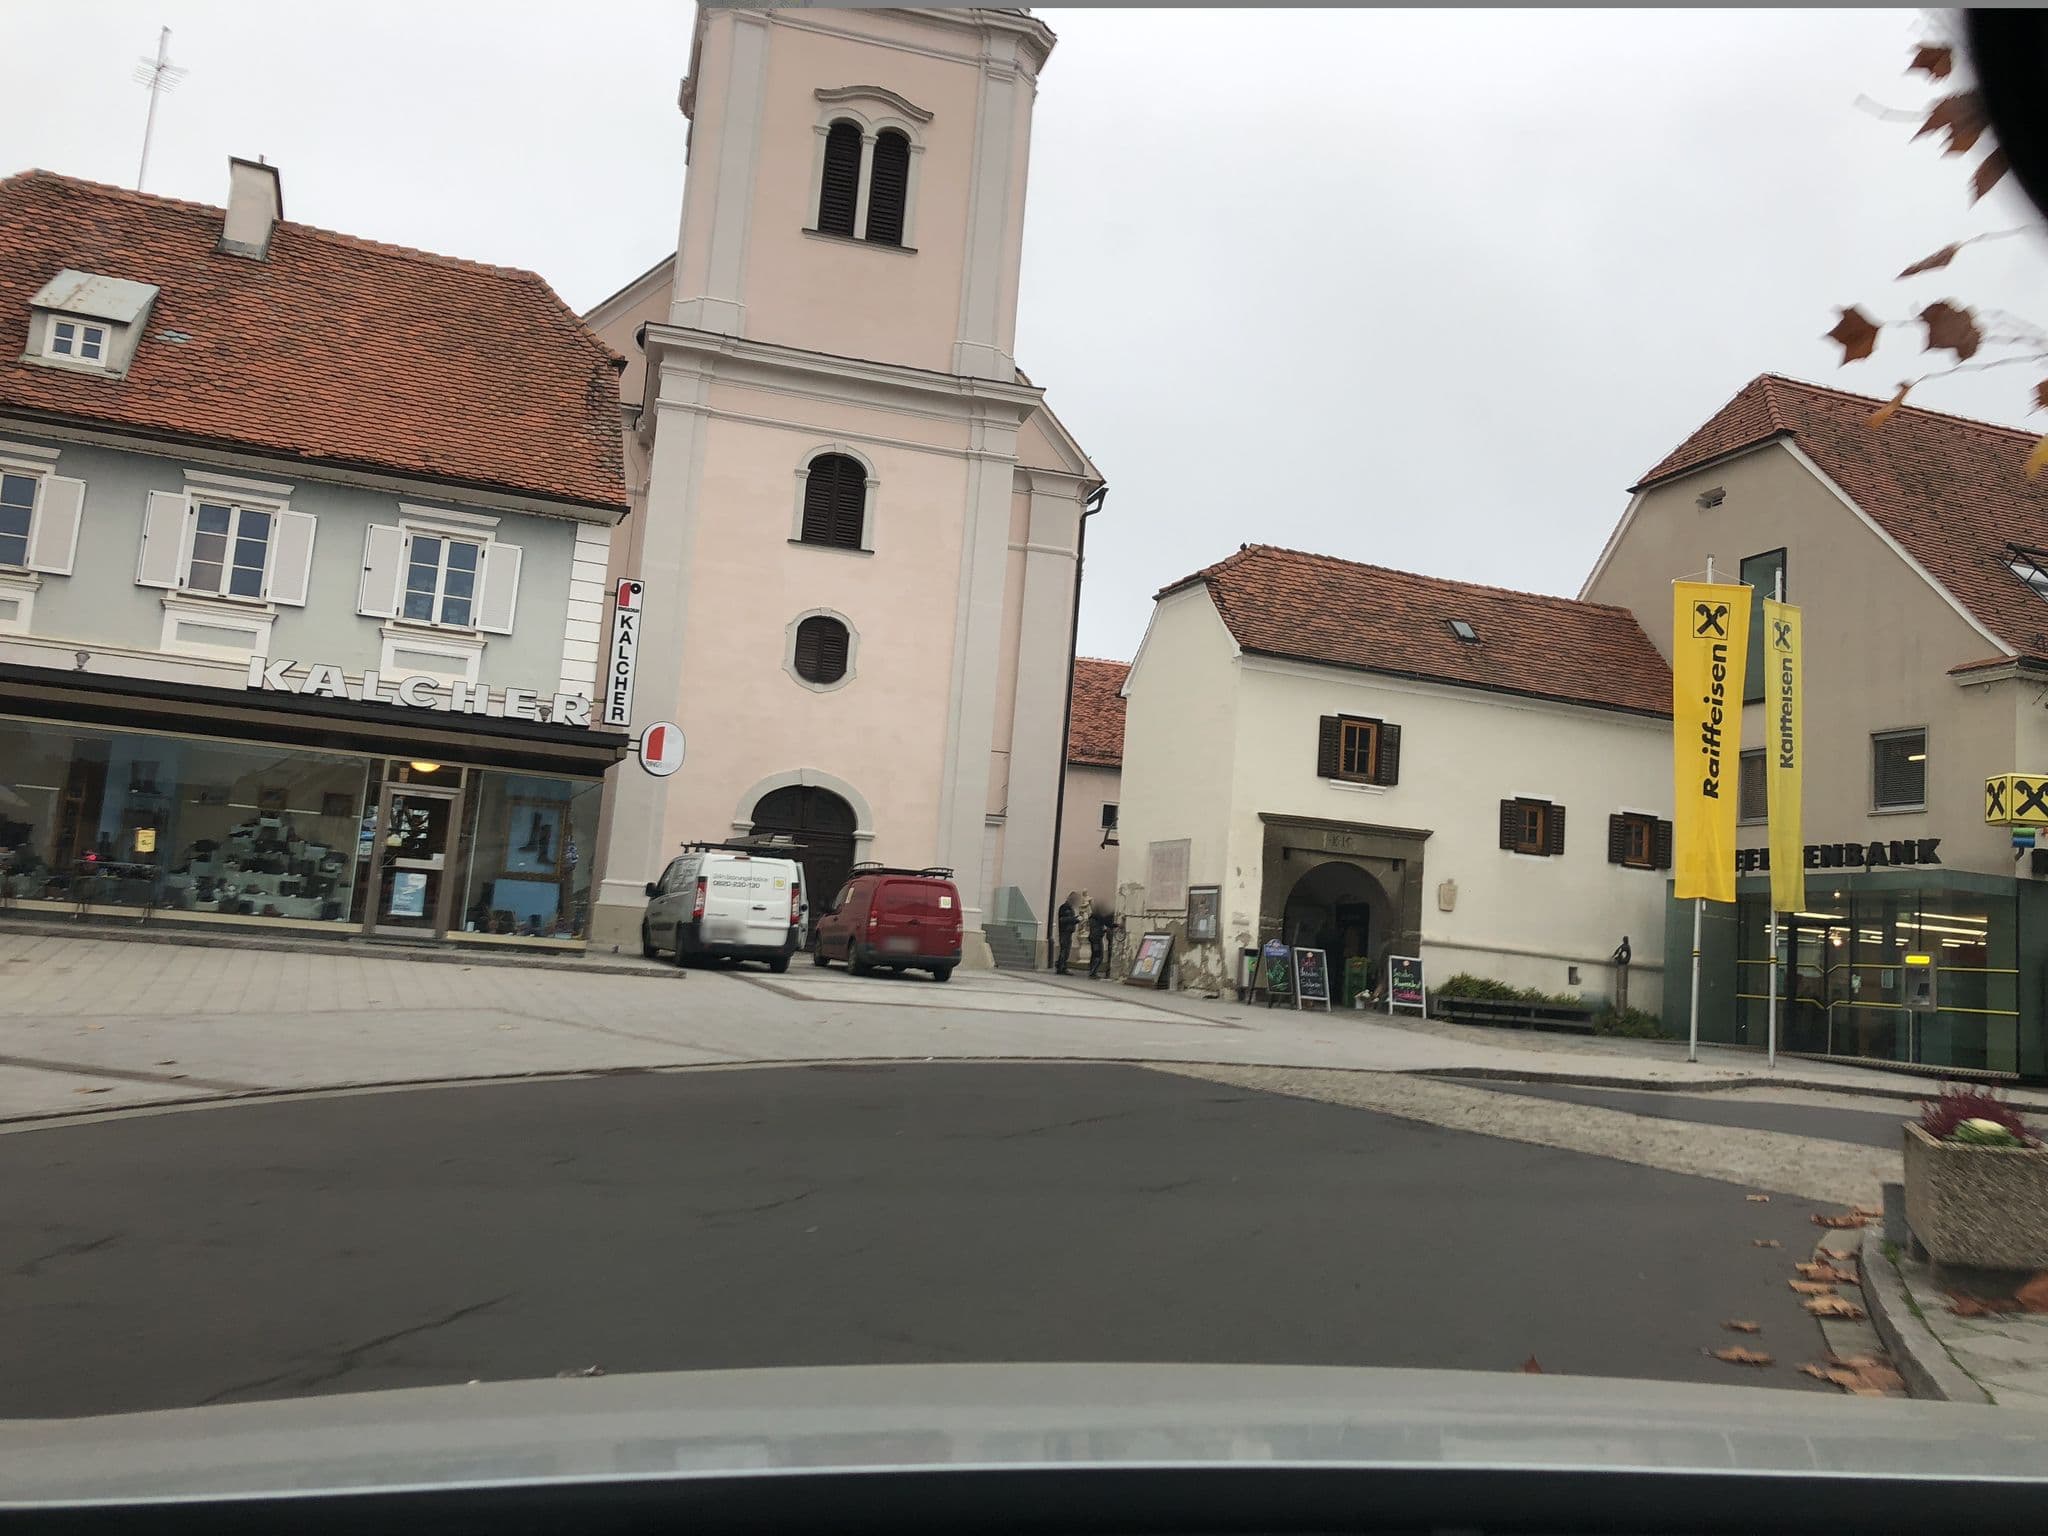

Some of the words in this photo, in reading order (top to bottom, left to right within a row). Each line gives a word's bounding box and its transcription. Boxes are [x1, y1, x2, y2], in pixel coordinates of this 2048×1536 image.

[246, 656, 594, 729] KALCHER
[611, 614, 633, 722] KALCHER
[1702, 643, 1728, 799] Raiffeisen
